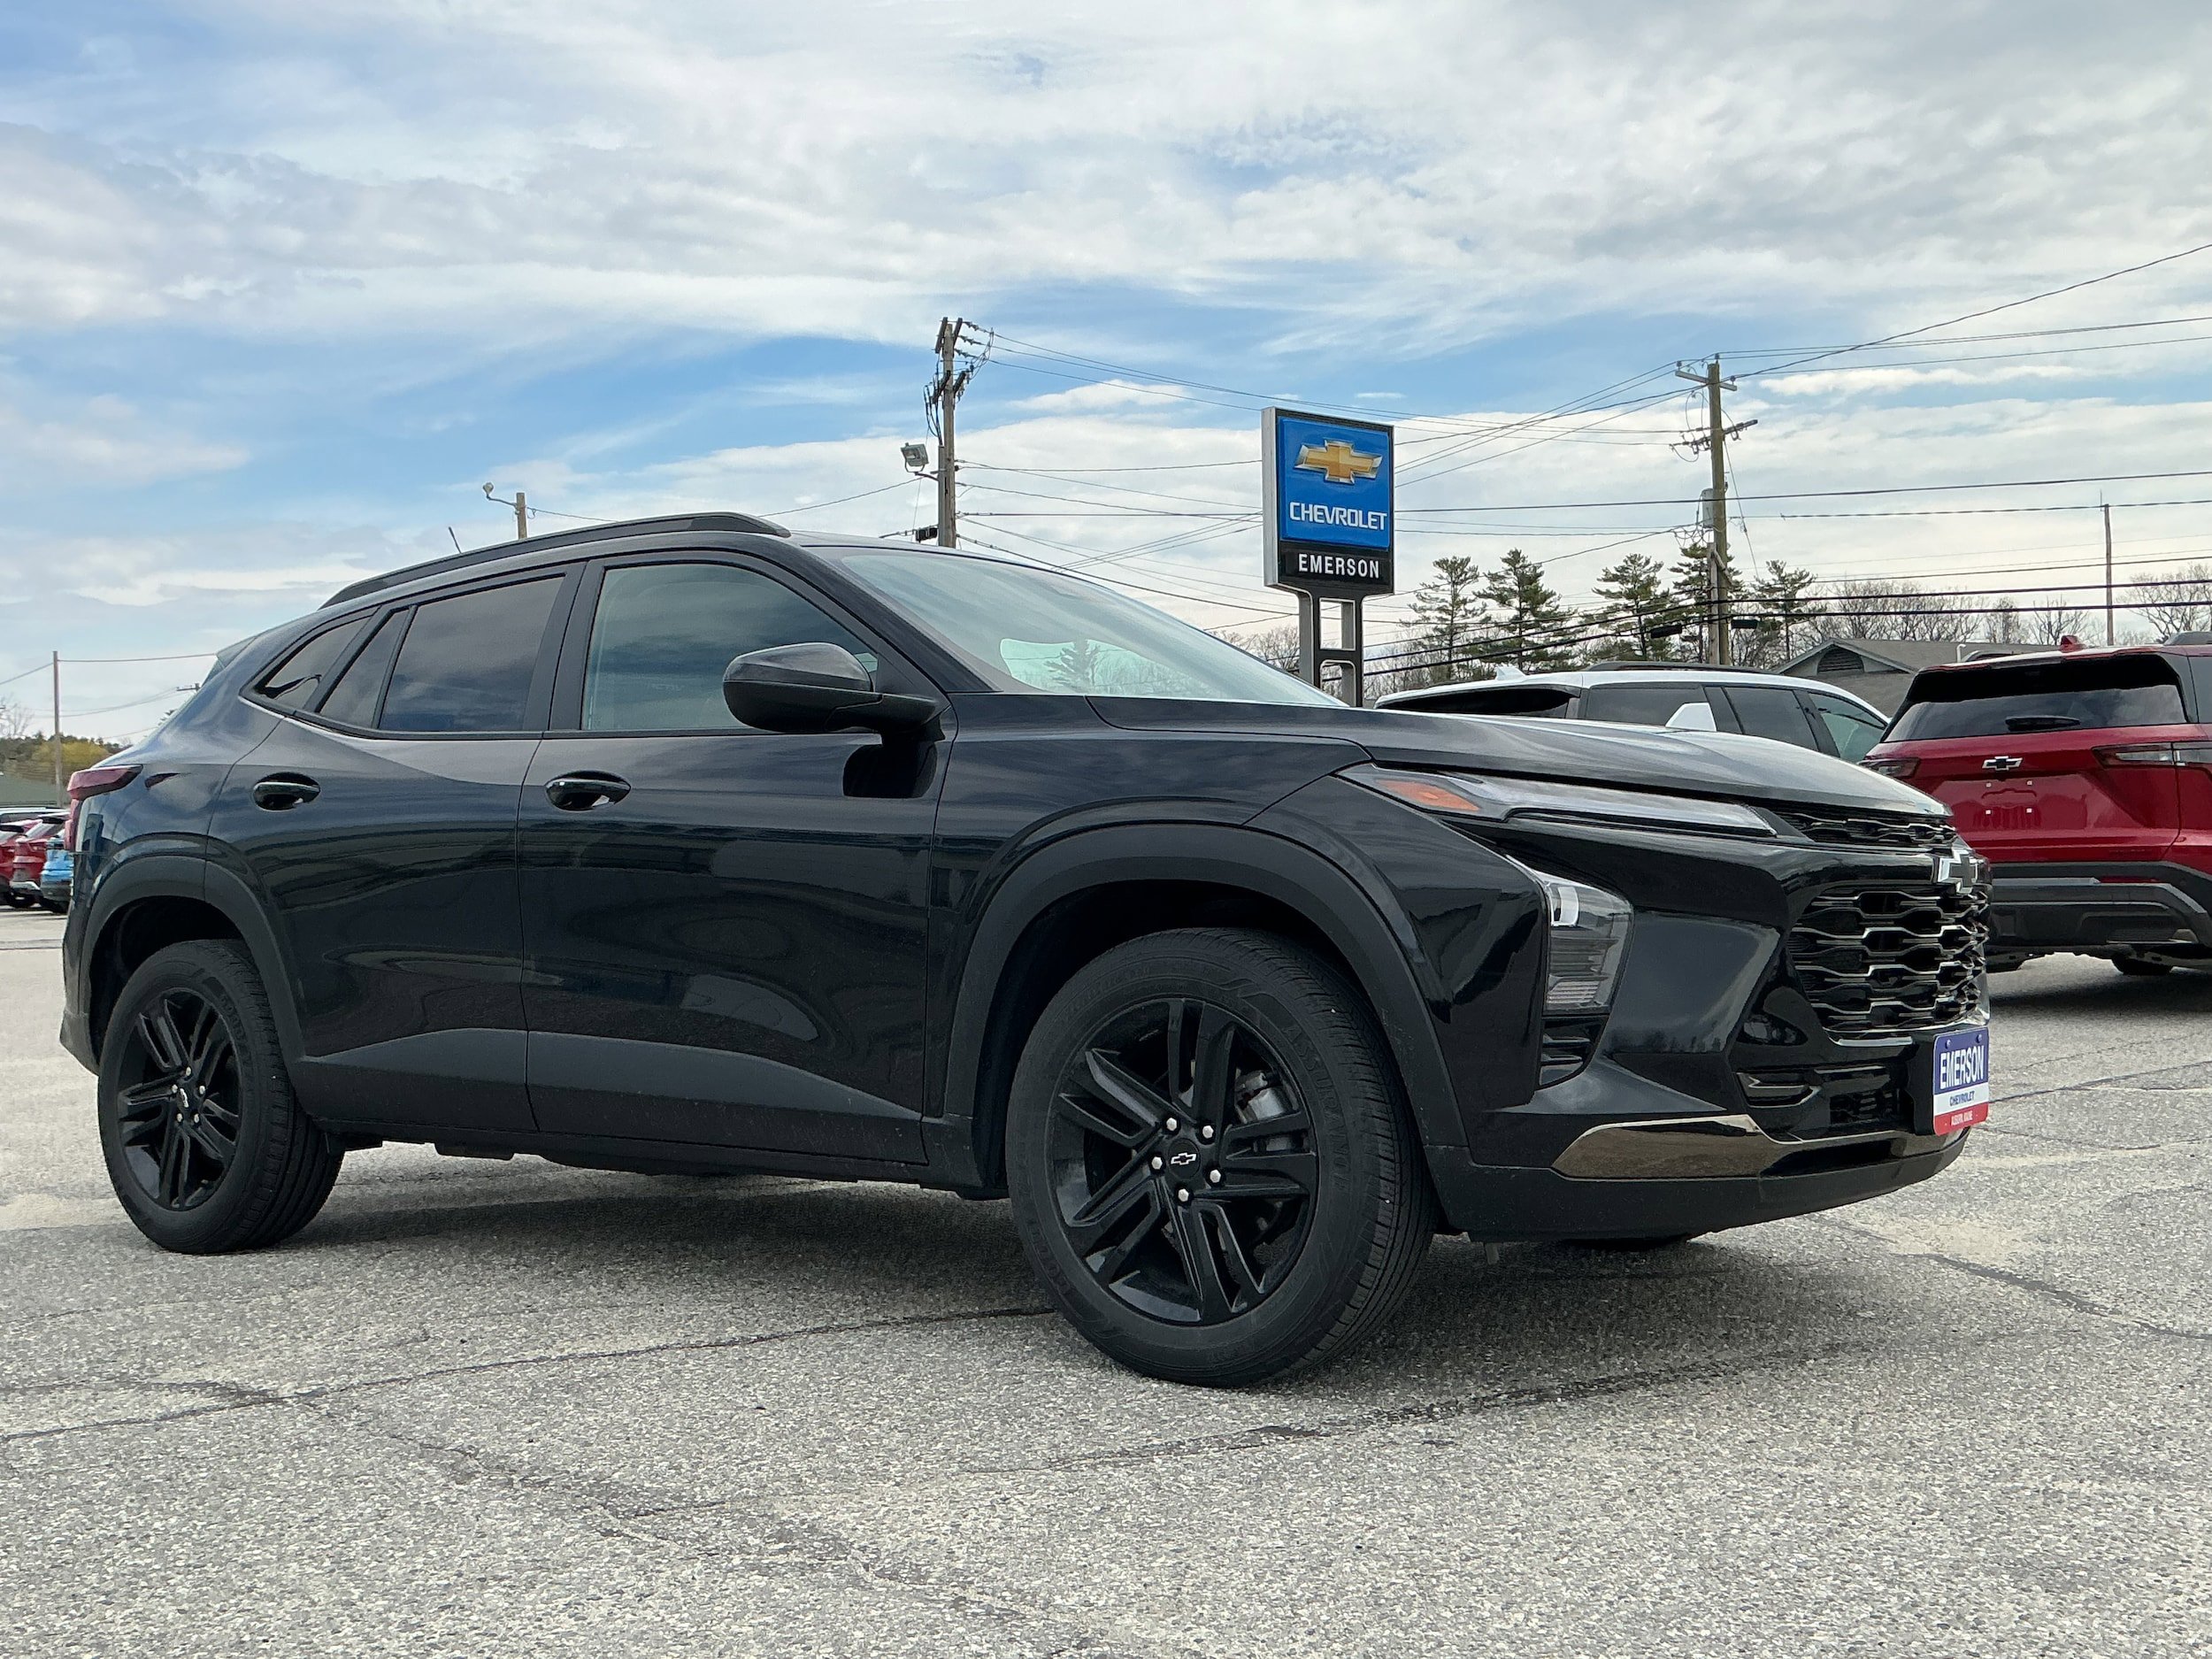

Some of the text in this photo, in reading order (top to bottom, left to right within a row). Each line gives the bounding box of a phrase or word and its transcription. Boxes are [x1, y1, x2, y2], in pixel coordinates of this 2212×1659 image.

[1289, 502, 1387, 530] CHEVROLET
[1298, 554, 1379, 579] EMERSON
[1939, 1045, 1984, 1089] EMERSON
[1949, 1091, 1974, 1106] CHEVROLET
